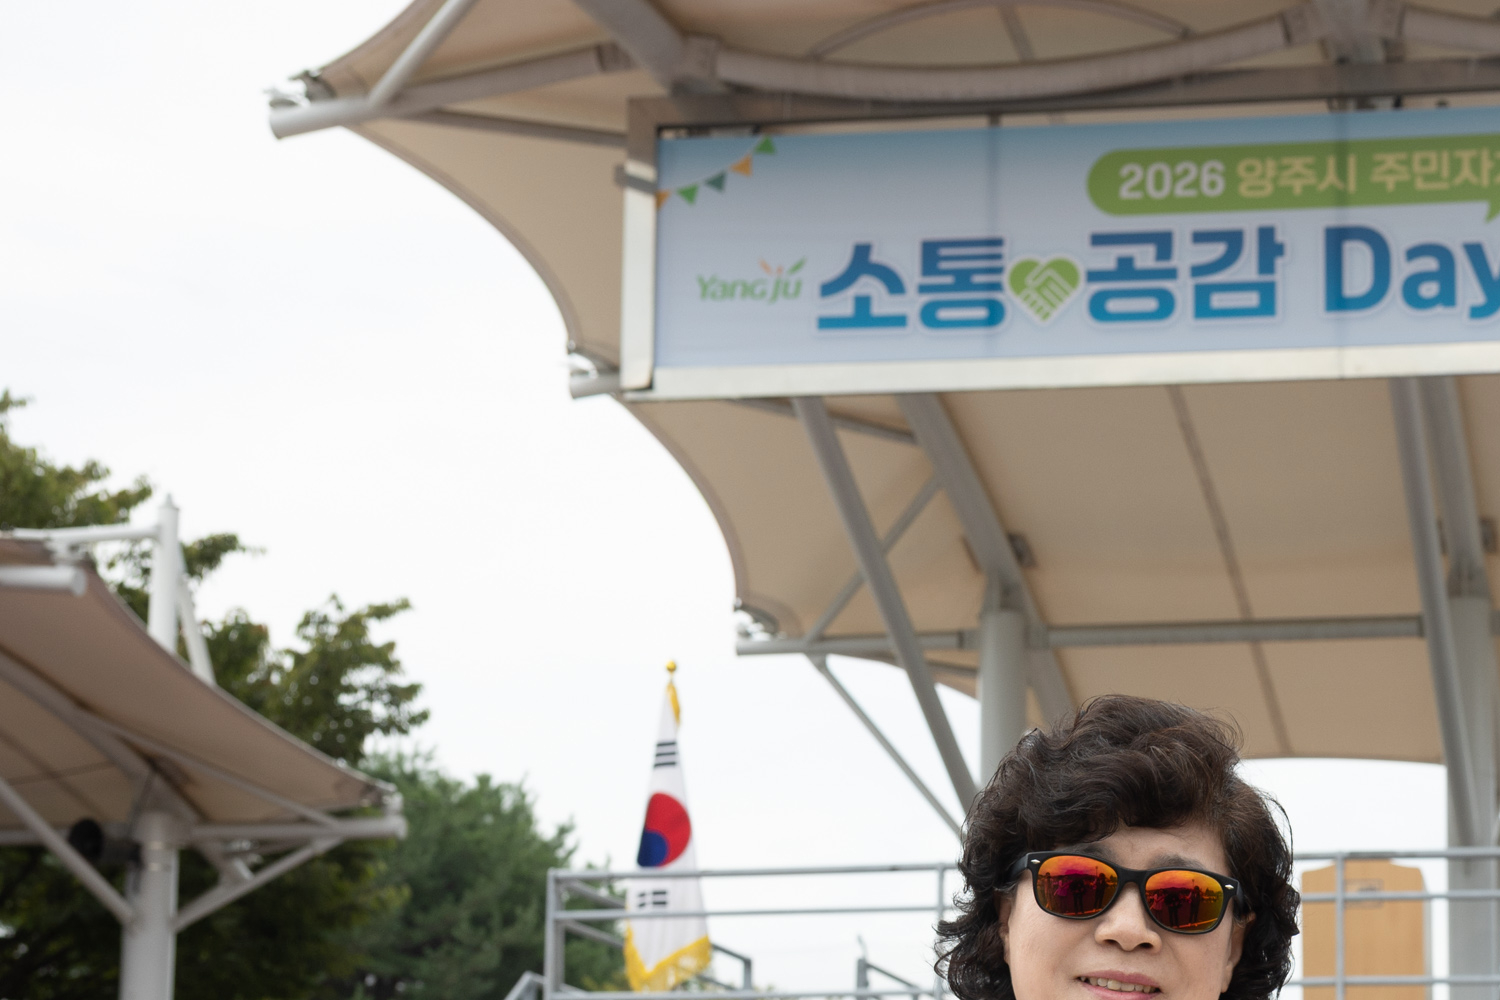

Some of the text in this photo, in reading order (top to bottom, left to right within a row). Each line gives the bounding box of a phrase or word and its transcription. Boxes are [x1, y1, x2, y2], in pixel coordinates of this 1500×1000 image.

[1118, 160, 1226, 201] 2026
[1236, 148, 1358, 198] 양주시
[817, 236, 1006, 331] 소통
[1085, 225, 1285, 323] 공감
